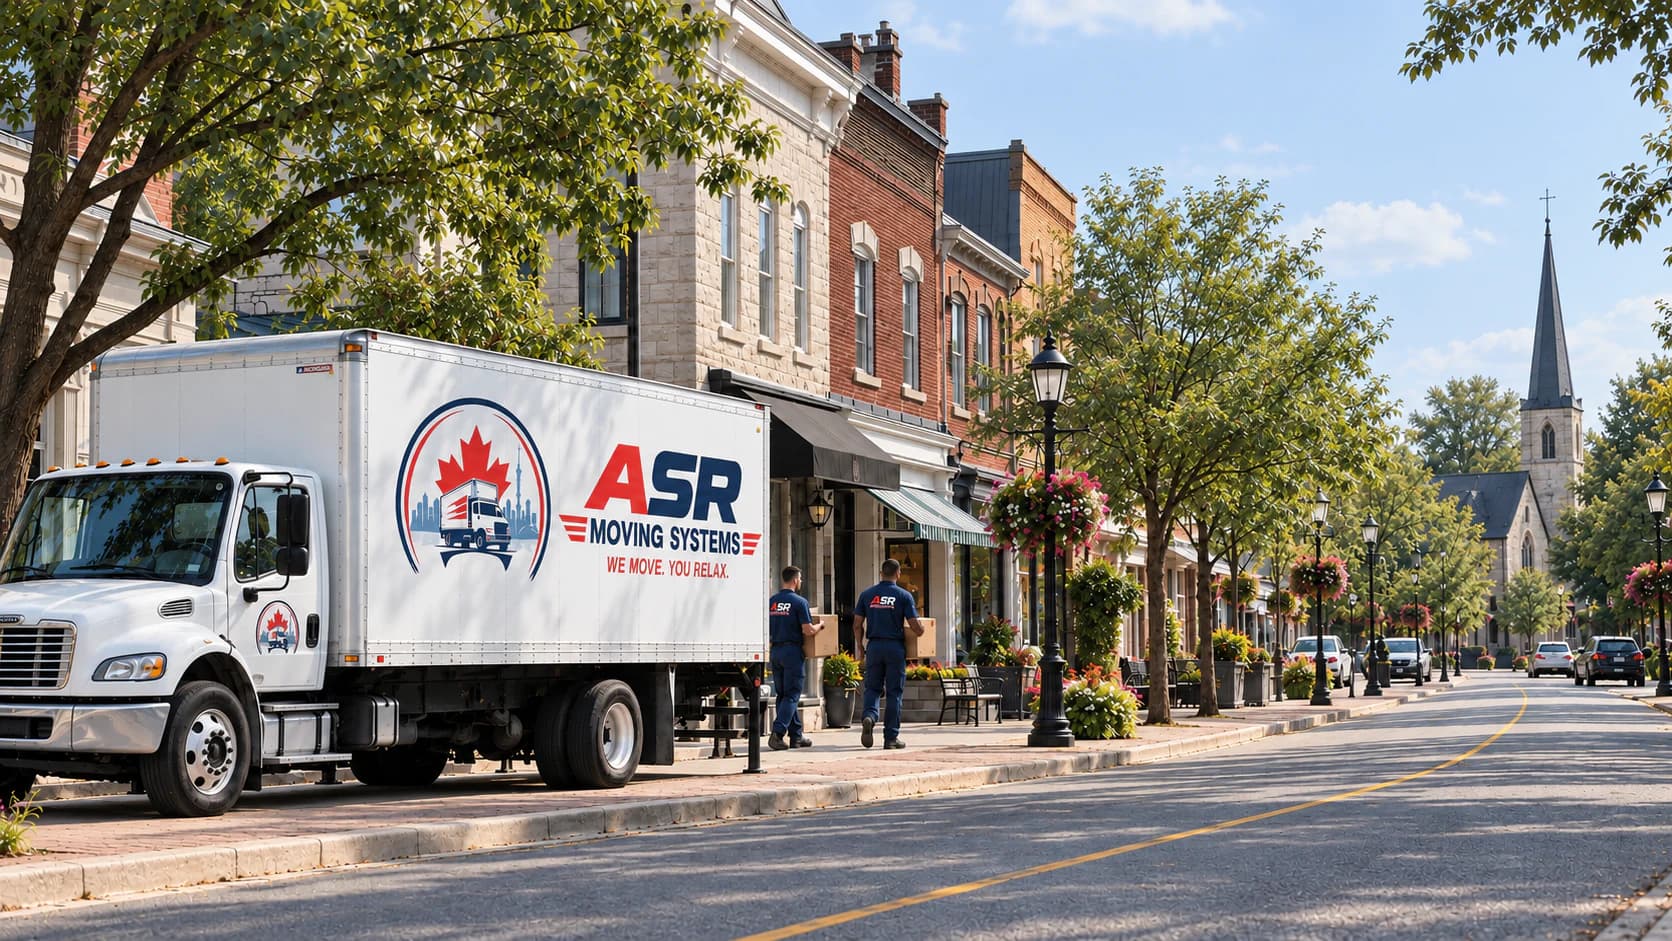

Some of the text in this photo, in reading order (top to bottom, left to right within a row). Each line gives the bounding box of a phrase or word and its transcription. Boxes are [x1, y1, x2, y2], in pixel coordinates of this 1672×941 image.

[584, 443, 742, 524] ASR
[589, 518, 741, 555] MOVING SYSTEMS
[607, 556, 729, 579] WE MOVE. YOU RELAX.
[770, 602, 791, 612] ASR
[870, 595, 896, 606] ASR
